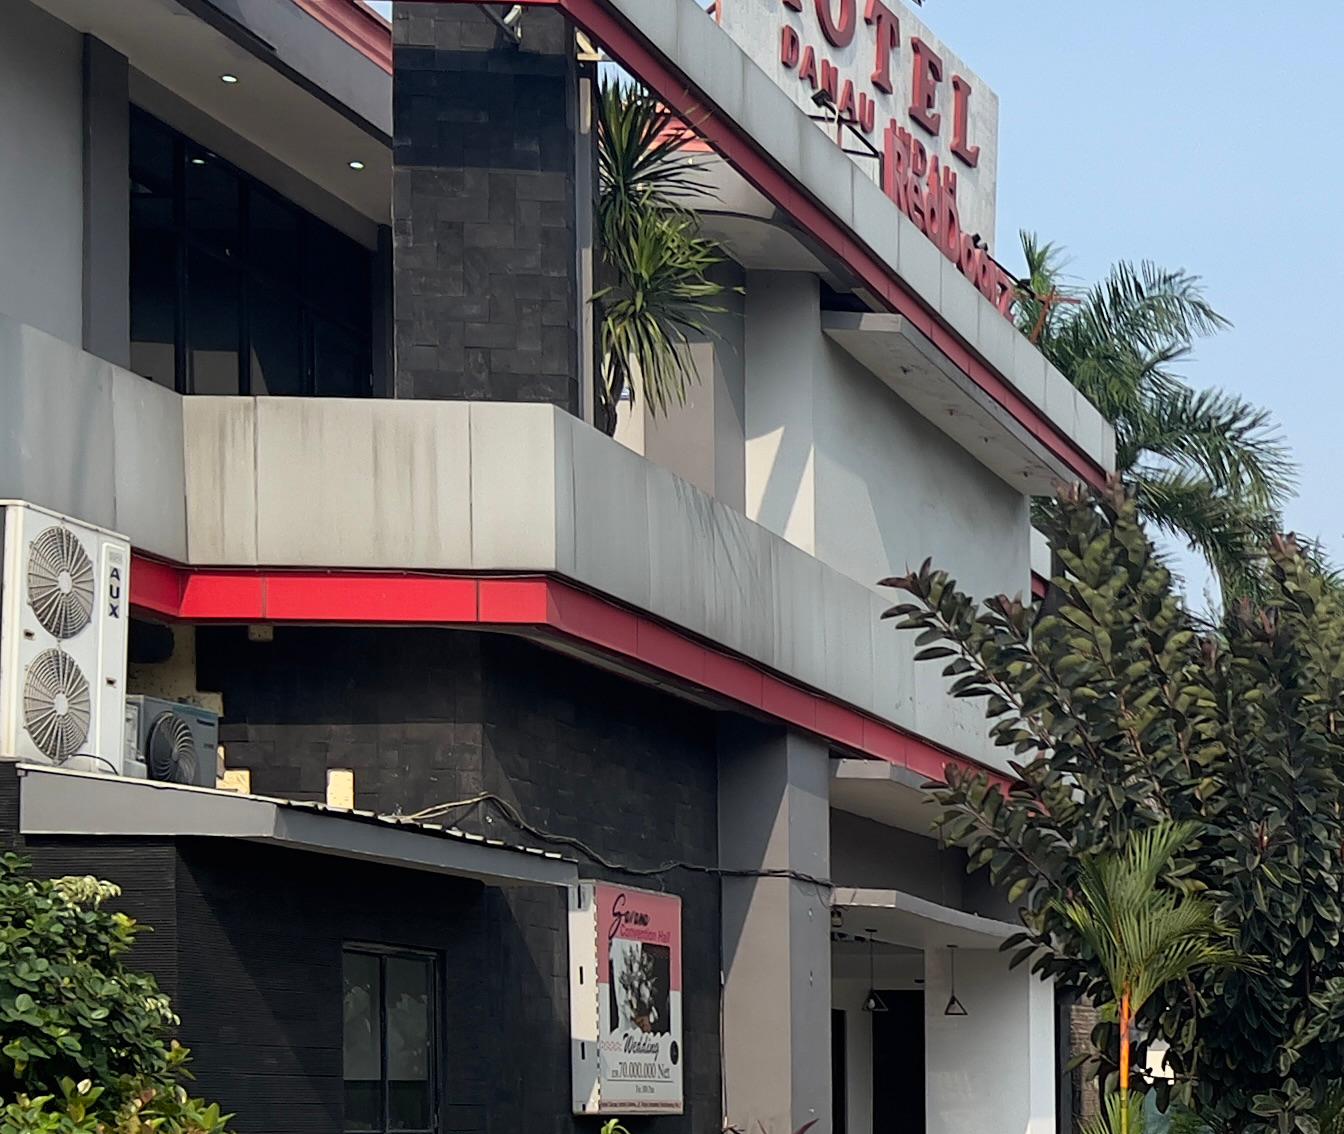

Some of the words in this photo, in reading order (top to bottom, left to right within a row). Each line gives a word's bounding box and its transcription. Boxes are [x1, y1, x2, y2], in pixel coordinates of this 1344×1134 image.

[781, 24, 875, 134] DANAU
[890, 118, 957, 202] DAH
[782, 0, 980, 169] OTEL
[109, 567, 121, 619] AUX
[622, 1033, 659, 1061] Wedding
